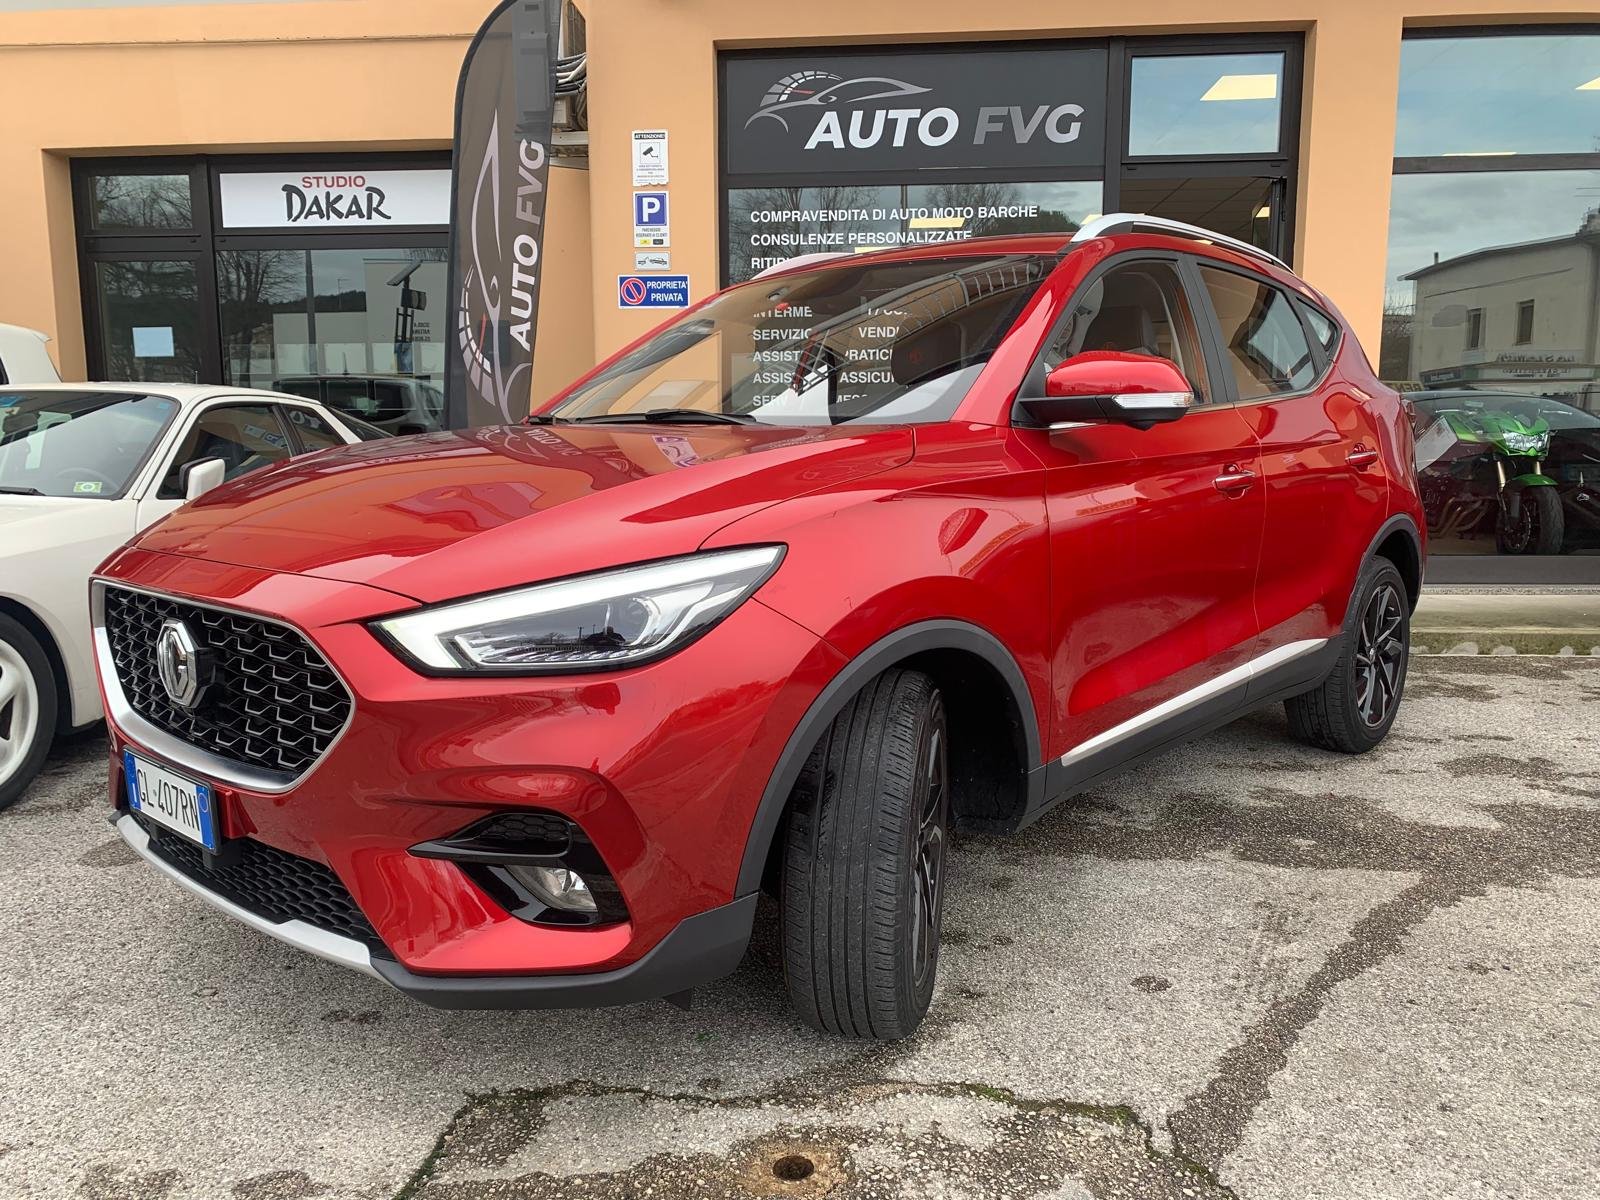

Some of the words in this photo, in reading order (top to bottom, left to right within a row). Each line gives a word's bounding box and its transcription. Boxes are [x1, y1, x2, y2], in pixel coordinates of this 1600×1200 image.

[804, 107, 959, 150] AUTO
[973, 103, 1085, 145] FVG
[301, 175, 366, 188] STUDIO
[514, 138, 546, 225] FVG
[281, 184, 392, 222] DAKAR
[642, 197, 660, 223] P
[750, 209, 869, 223] COMPRAVENDITA
[872, 209, 886, 221] DI
[890, 208, 928, 220] AUTO
[932, 207, 974, 220] MOTO
[978, 205, 1038, 219] BARCHE
[750, 233, 845, 246] CONSULENZE
[848, 230, 972, 244] PERSONALIZZATE
[509, 234, 539, 352] AUTO
[651, 292, 684, 302] PRIVATA
[858, 326, 900, 338] VEND
[753, 350, 804, 362] ASSIST
[845, 348, 893, 361] RATIC
[753, 372, 796, 384] ASSIS
[840, 371, 895, 384] ASSICU
[137, 768, 154, 808] GL
[158, 778, 200, 832] 407RN
